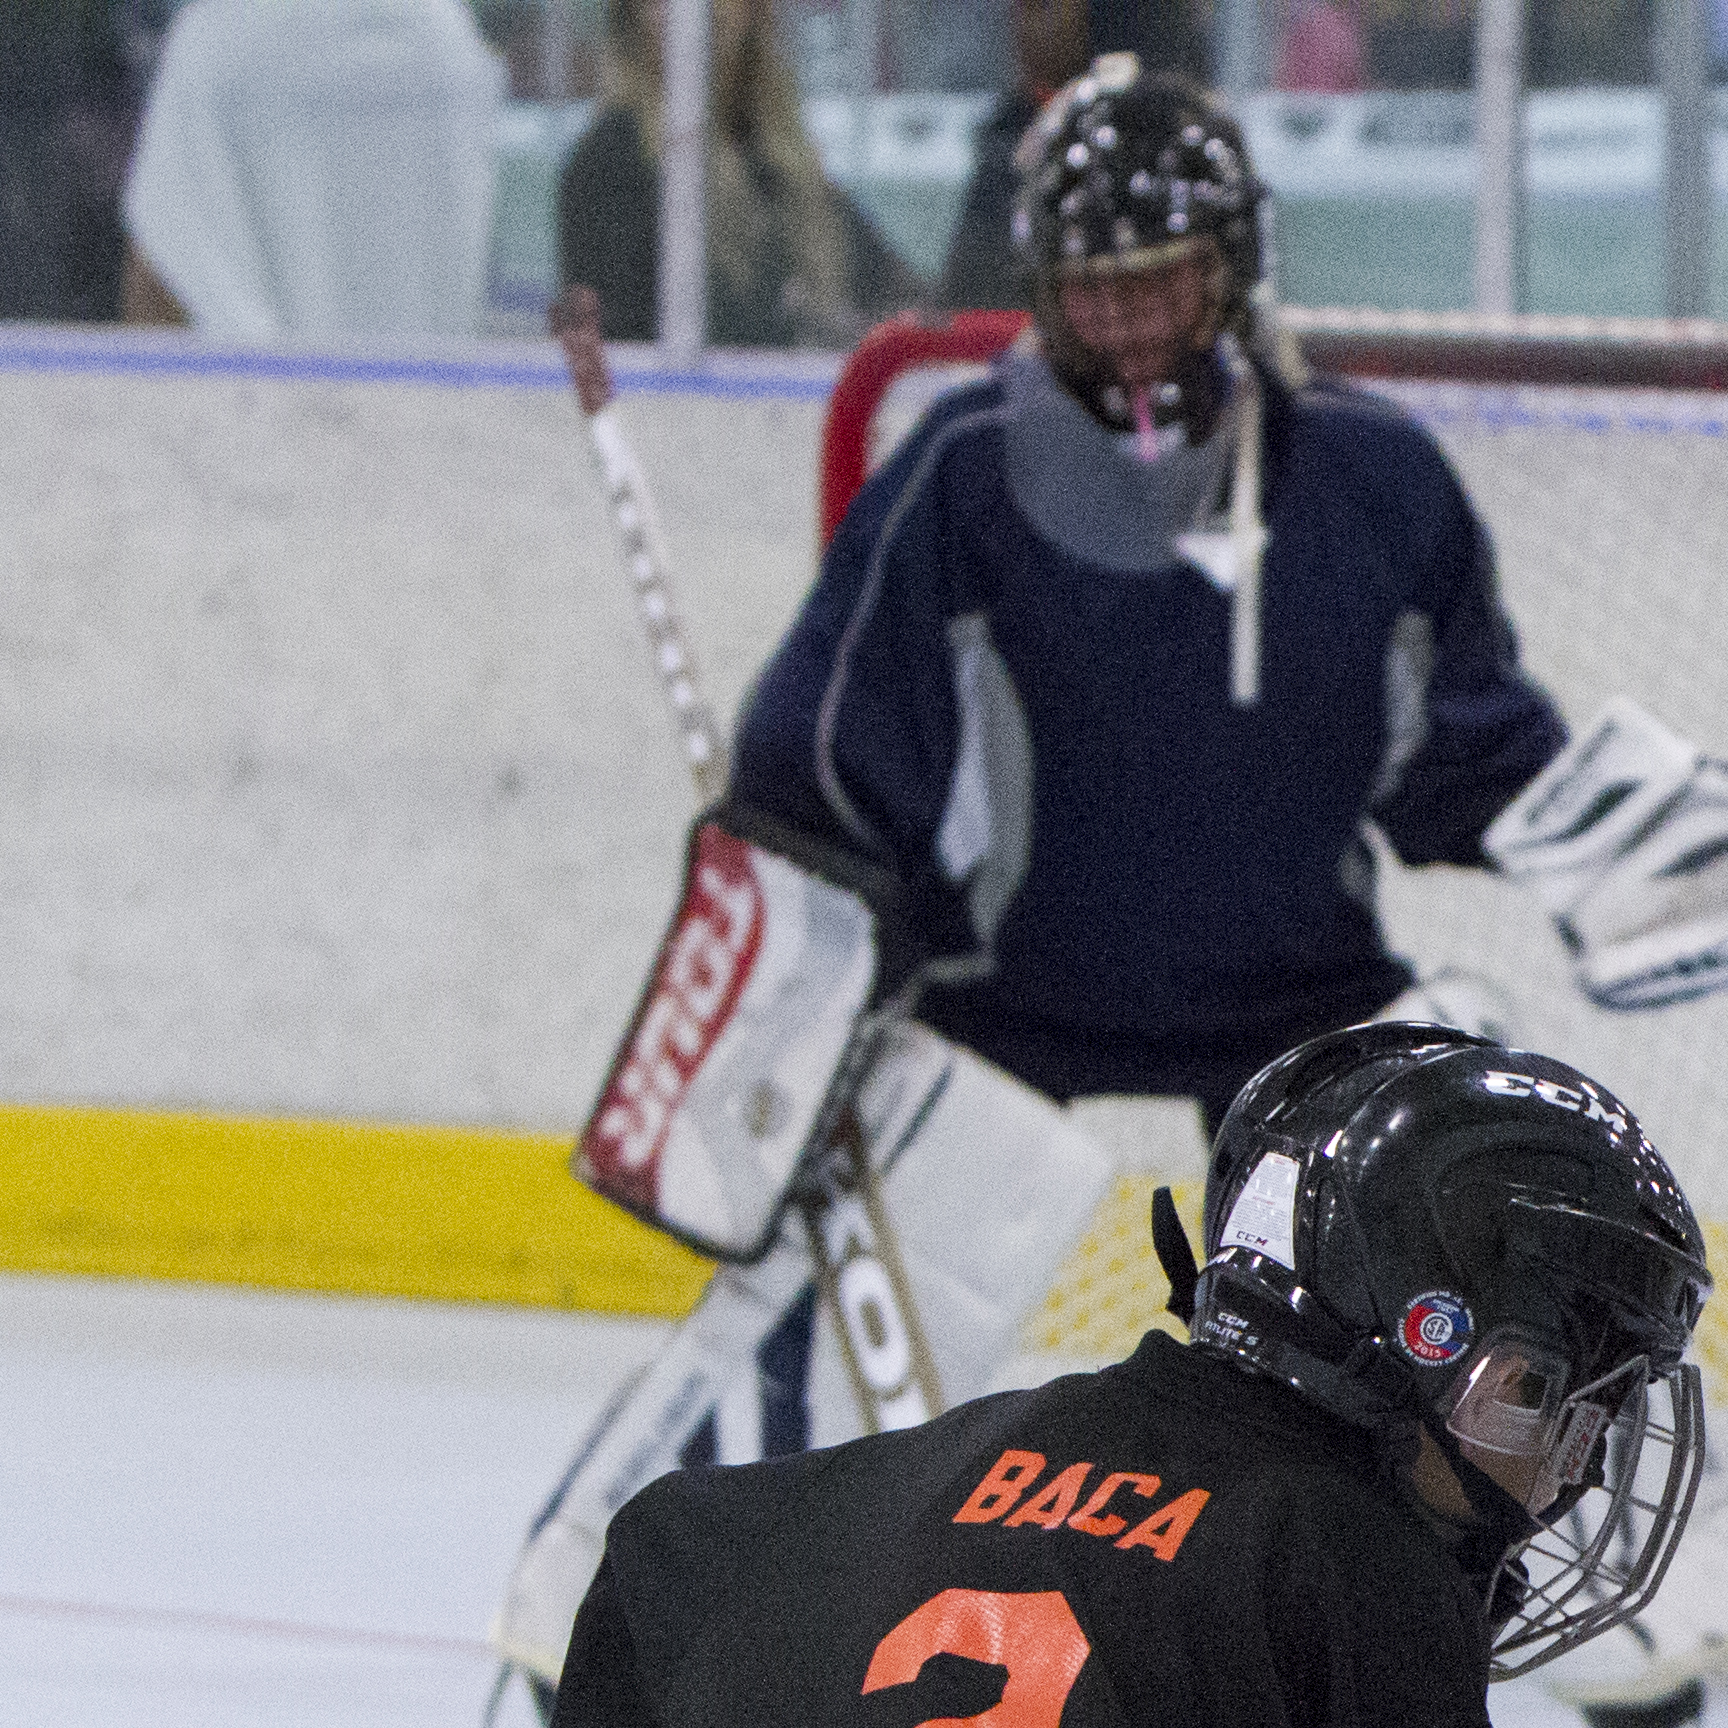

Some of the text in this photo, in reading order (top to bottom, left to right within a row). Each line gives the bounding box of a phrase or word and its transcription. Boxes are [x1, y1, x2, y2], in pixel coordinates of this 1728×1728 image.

[1482, 1069, 1628, 1135] CCM
[1235, 1230, 1269, 1247] CCM
[952, 1449, 1212, 1562] BACA
